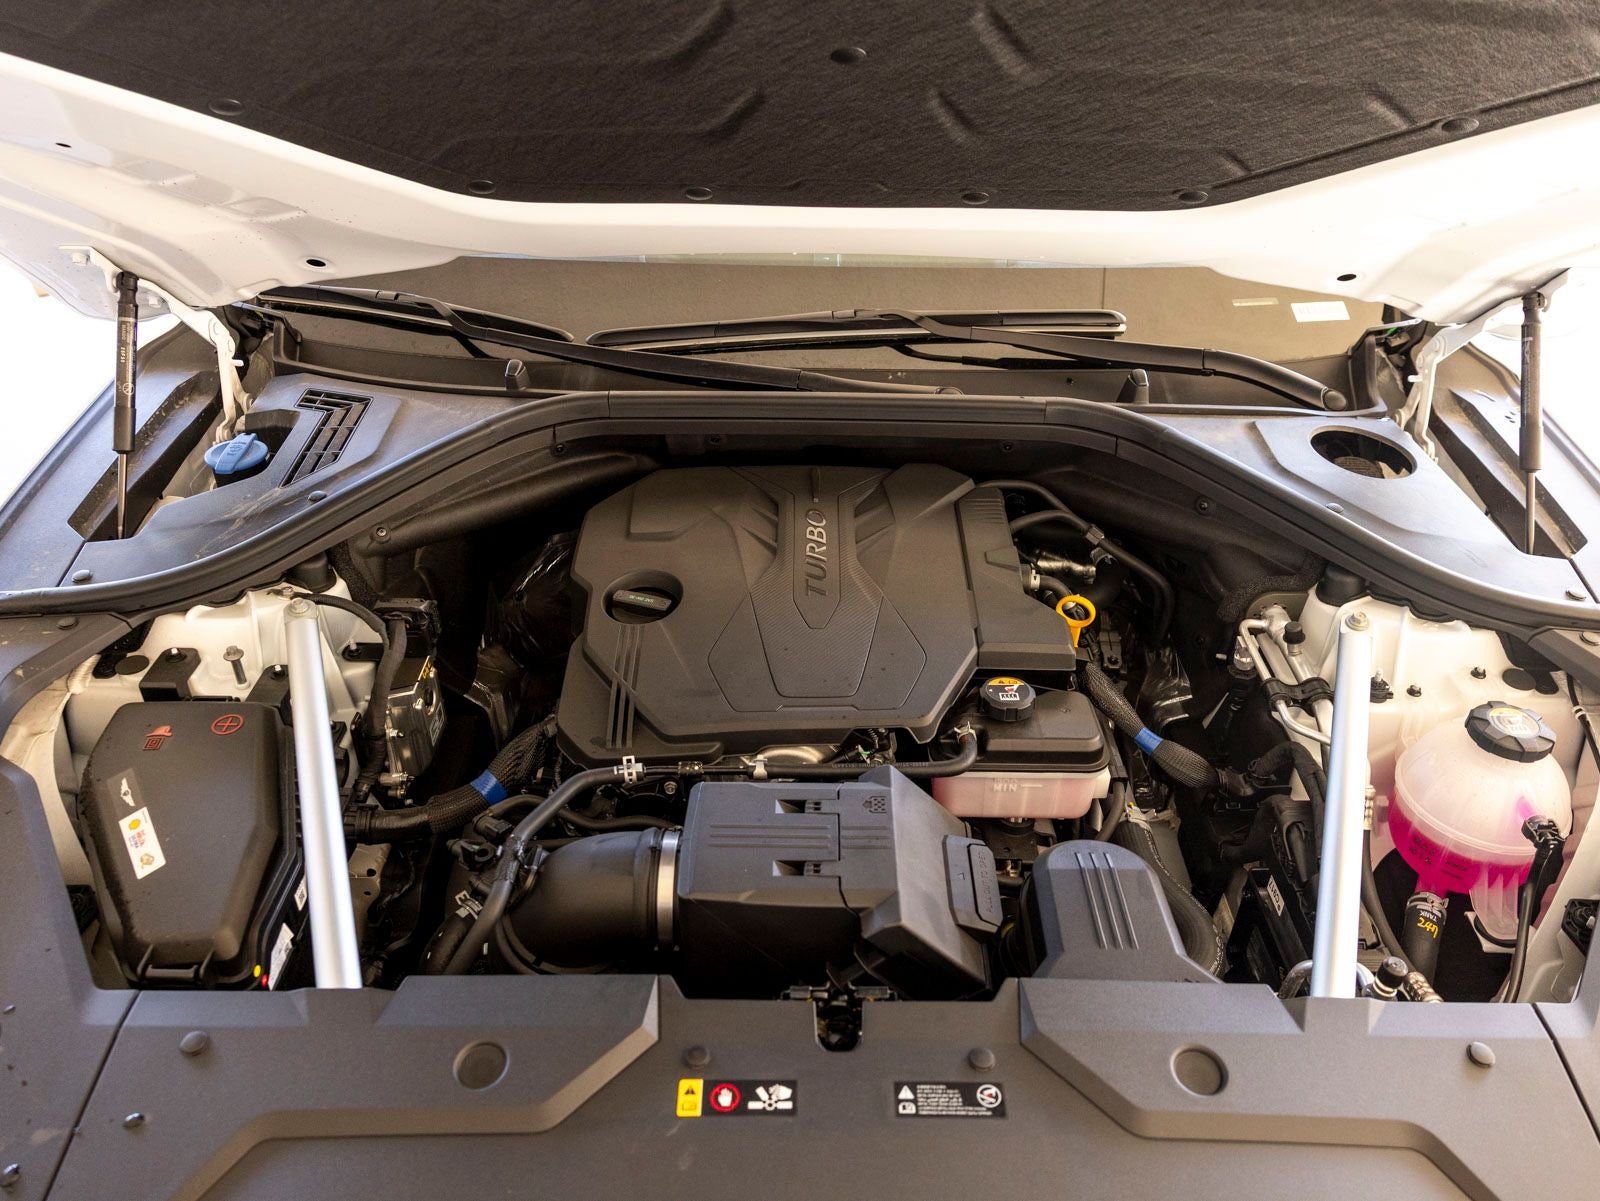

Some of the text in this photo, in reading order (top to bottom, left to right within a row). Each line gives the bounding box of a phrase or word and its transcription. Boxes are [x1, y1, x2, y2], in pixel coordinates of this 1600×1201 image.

[805, 509, 827, 596] TURBO
[993, 783, 1017, 792] MIN
[1419, 909, 1438, 922] TANK
